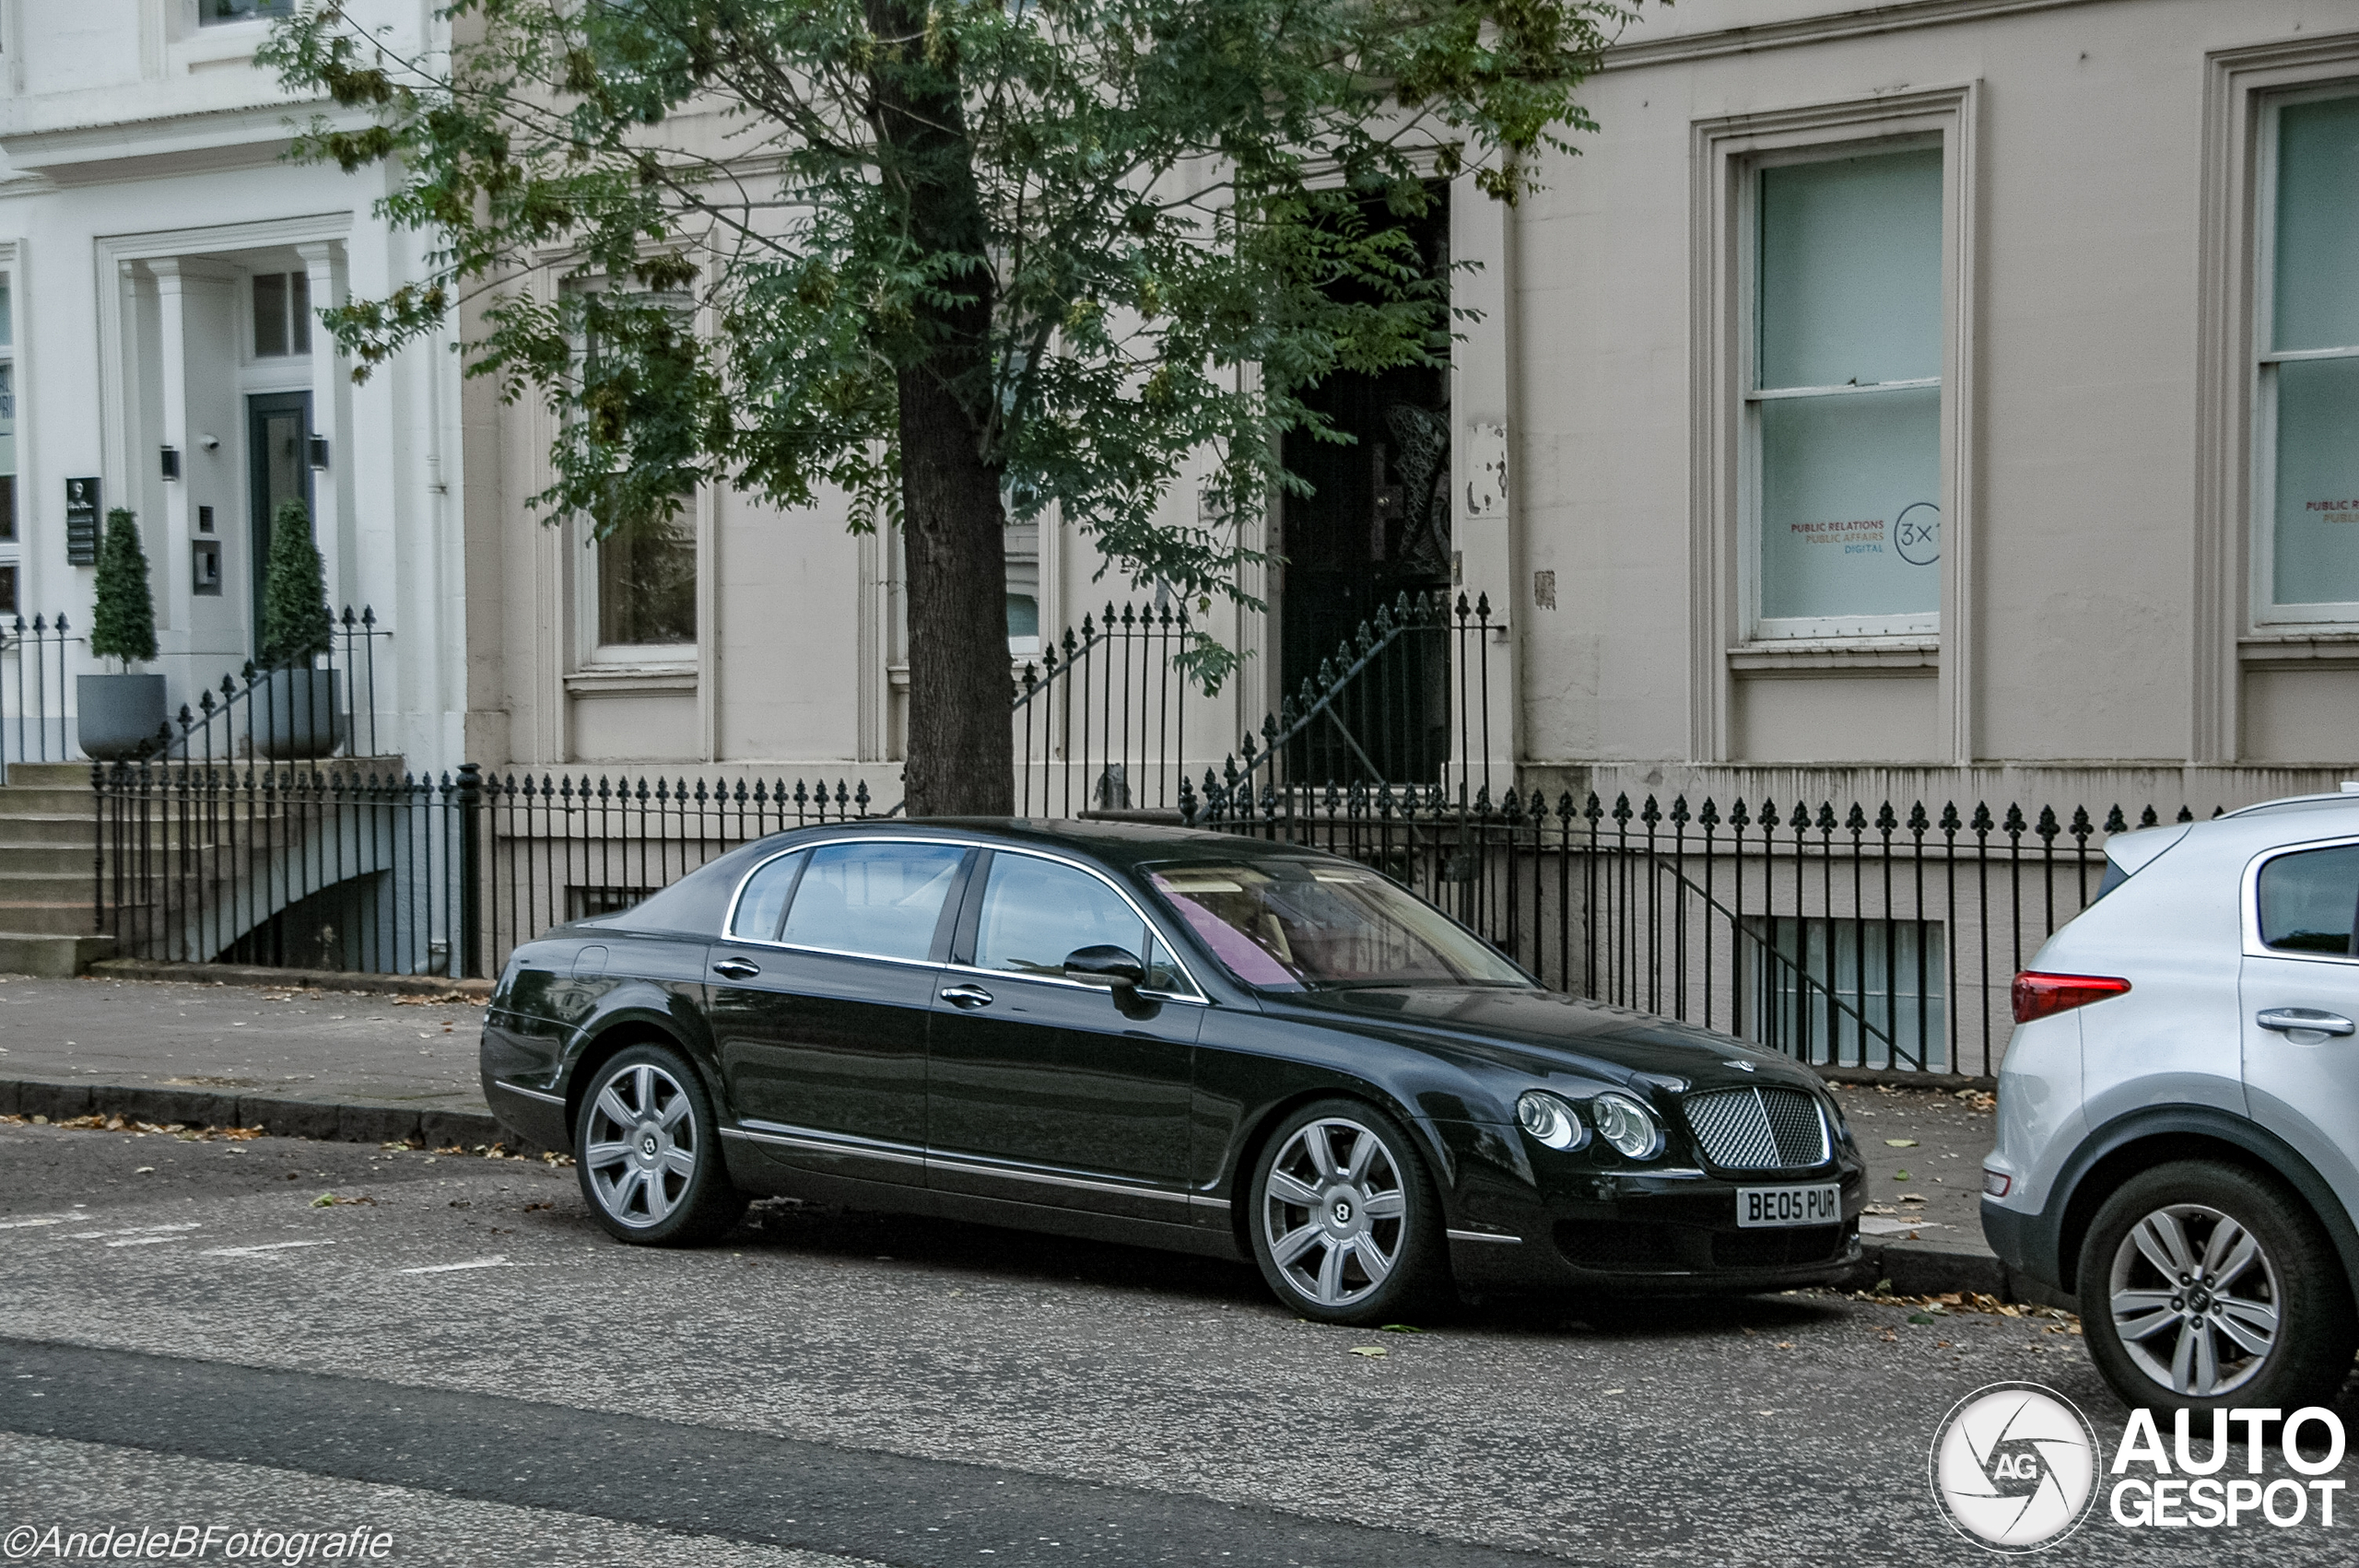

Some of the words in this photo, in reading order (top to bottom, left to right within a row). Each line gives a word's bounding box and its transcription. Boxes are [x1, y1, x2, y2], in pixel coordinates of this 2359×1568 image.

[2306, 500, 2349, 511] PUBLIC
[2323, 513, 2359, 523] PUBLI
[1790, 523, 1825, 533] PUBLIC
[1828, 520, 1884, 532] RELATIONS
[1806, 534, 1841, 544] PUBLIC
[1844, 532, 1884, 542] AFFAIRS
[1845, 544, 1883, 554] DIGITAL
[1748, 1192, 1802, 1221] BE05
[1807, 1188, 1836, 1218] PUR
